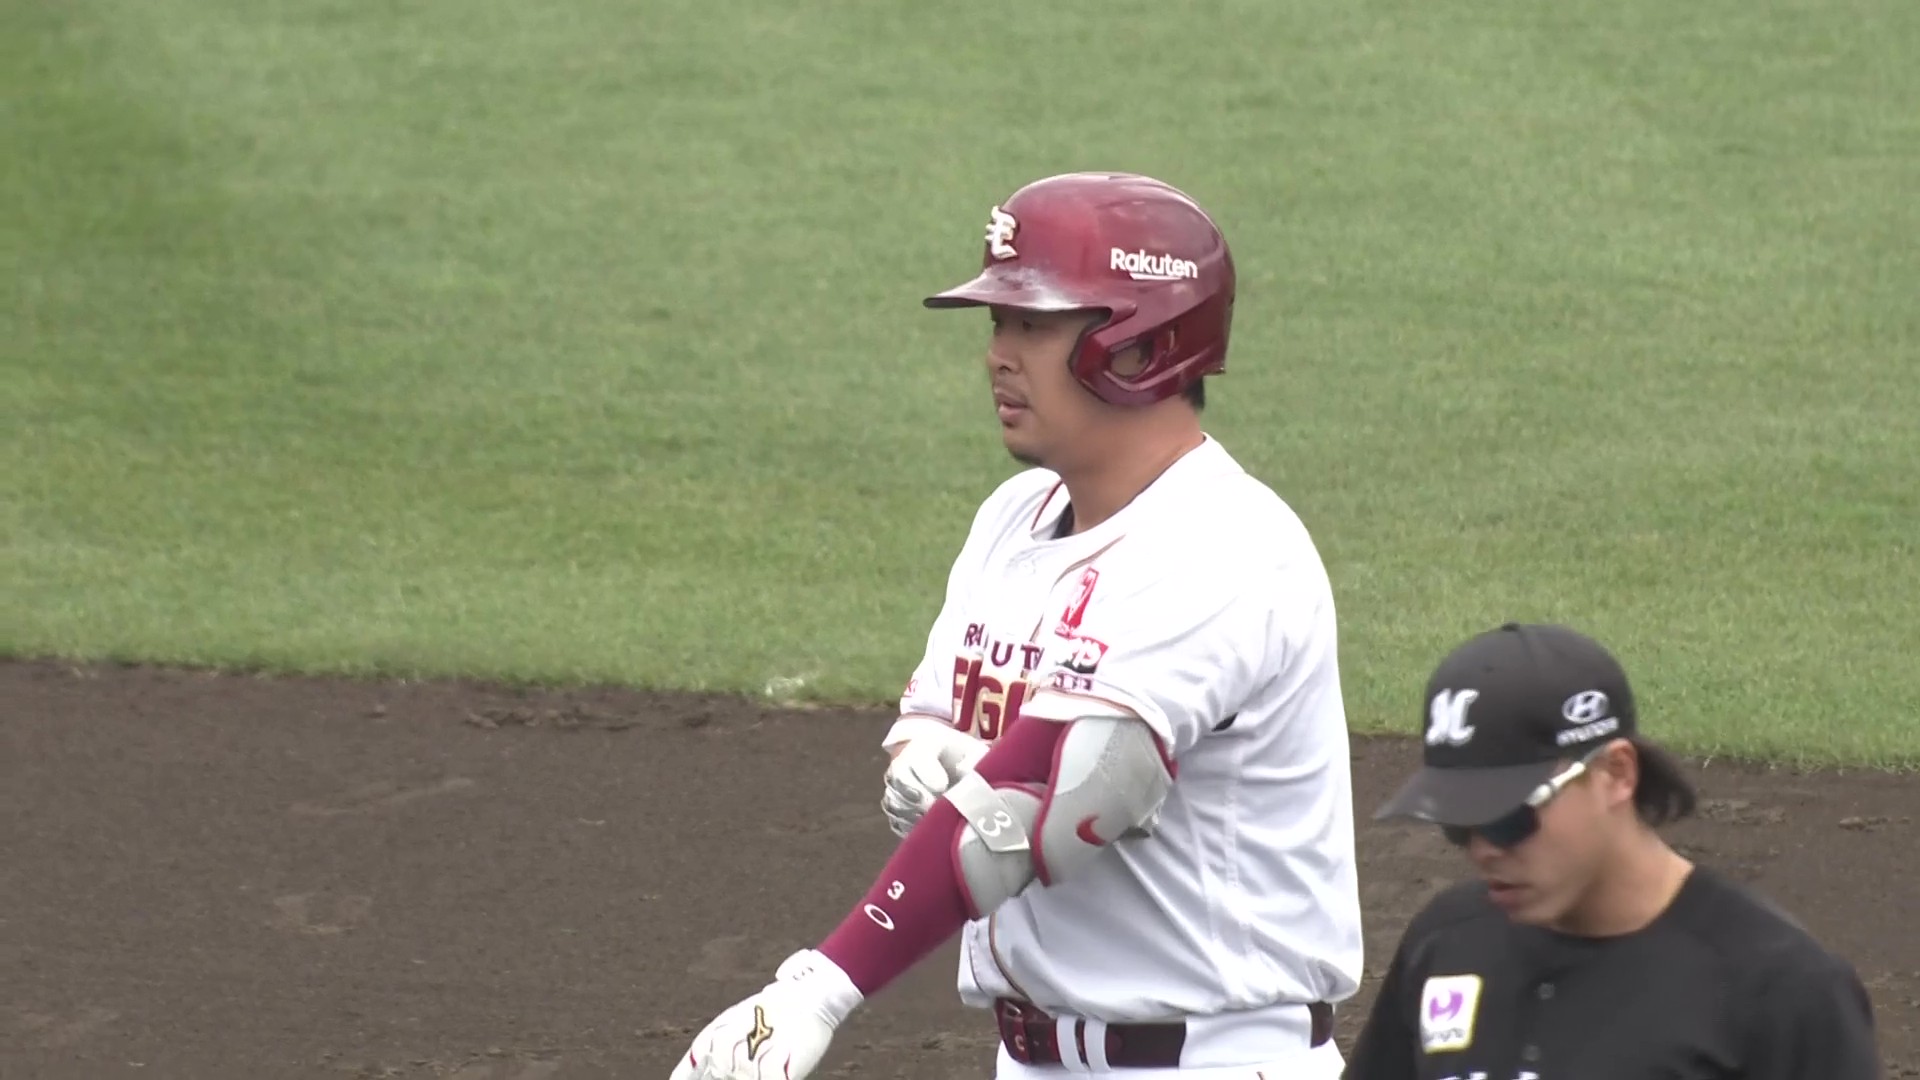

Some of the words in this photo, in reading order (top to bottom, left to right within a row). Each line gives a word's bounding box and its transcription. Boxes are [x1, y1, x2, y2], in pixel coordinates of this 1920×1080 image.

[1110, 247, 1198, 280] Rakuten
[977, 811, 1012, 837] 3
[887, 880, 905, 900] 3
